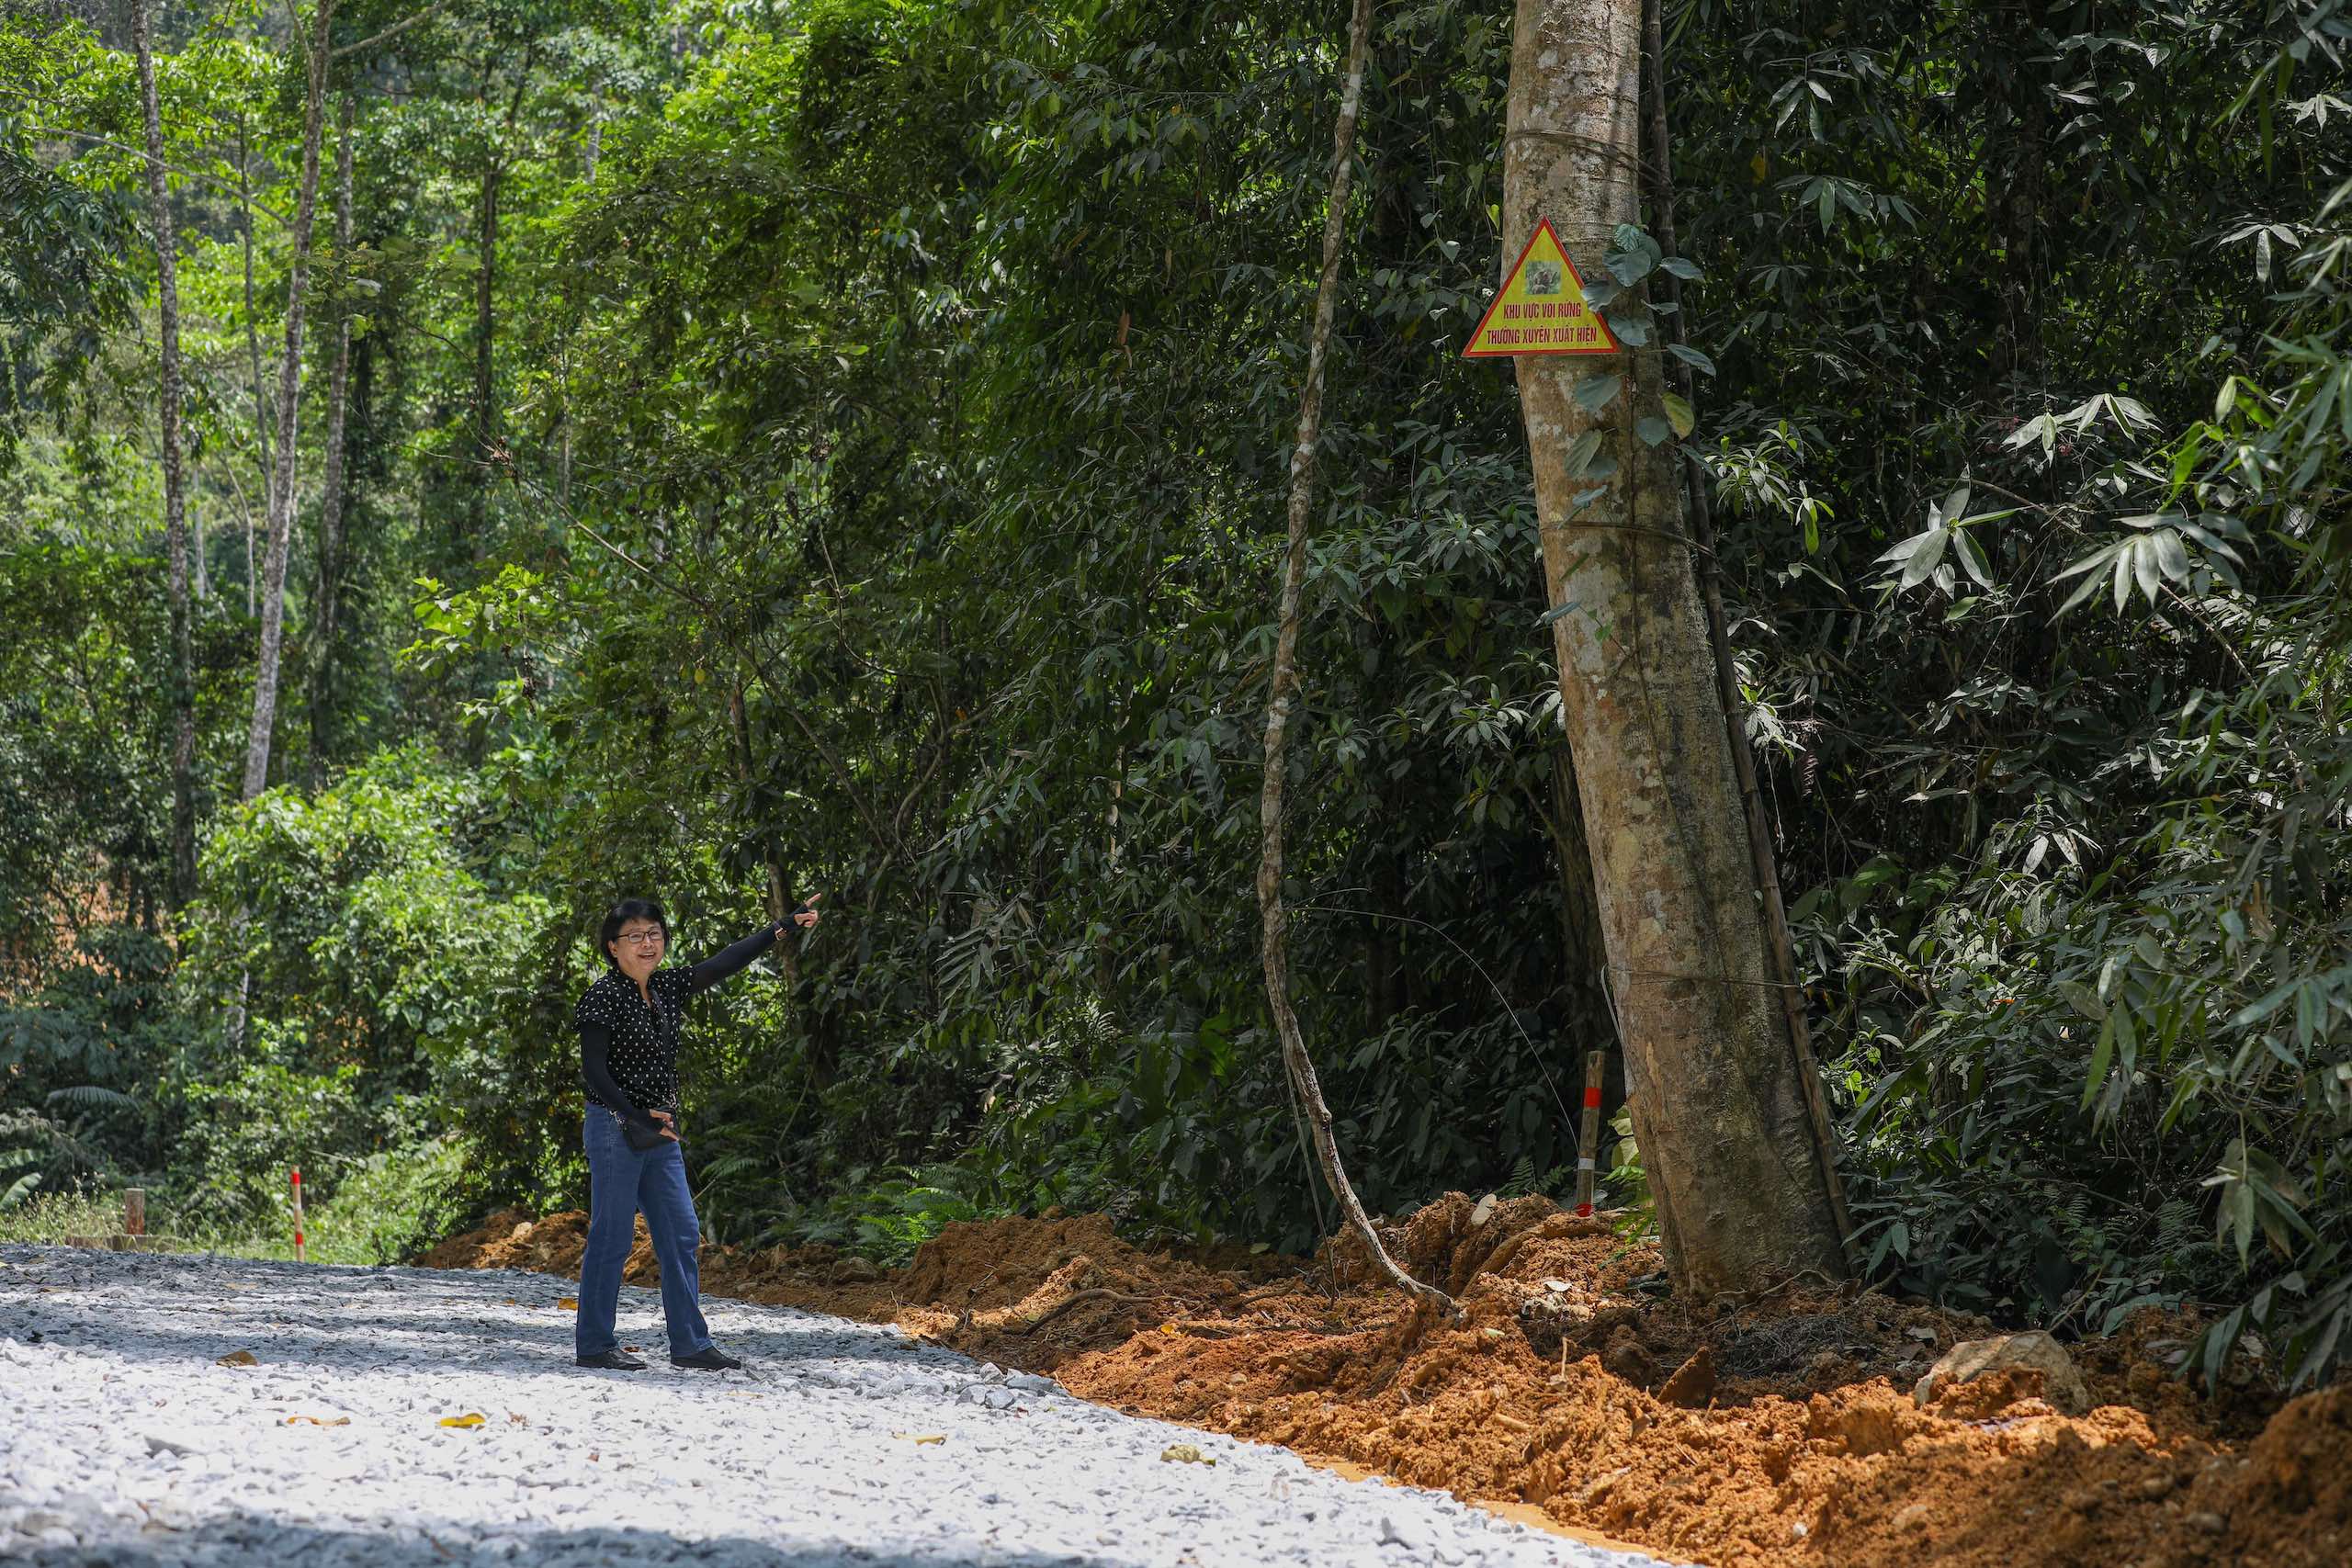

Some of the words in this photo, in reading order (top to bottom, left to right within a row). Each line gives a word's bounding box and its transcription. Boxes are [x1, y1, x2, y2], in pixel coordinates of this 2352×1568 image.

[1504, 304, 1521, 319] KHU
[1523, 302, 1540, 321] VỰC
[1542, 303, 1555, 318] VOI
[1522, 325, 1550, 344] XUYÊN
[1553, 322, 1575, 343] XUẤT
[1577, 324, 1597, 345] HIỆN
